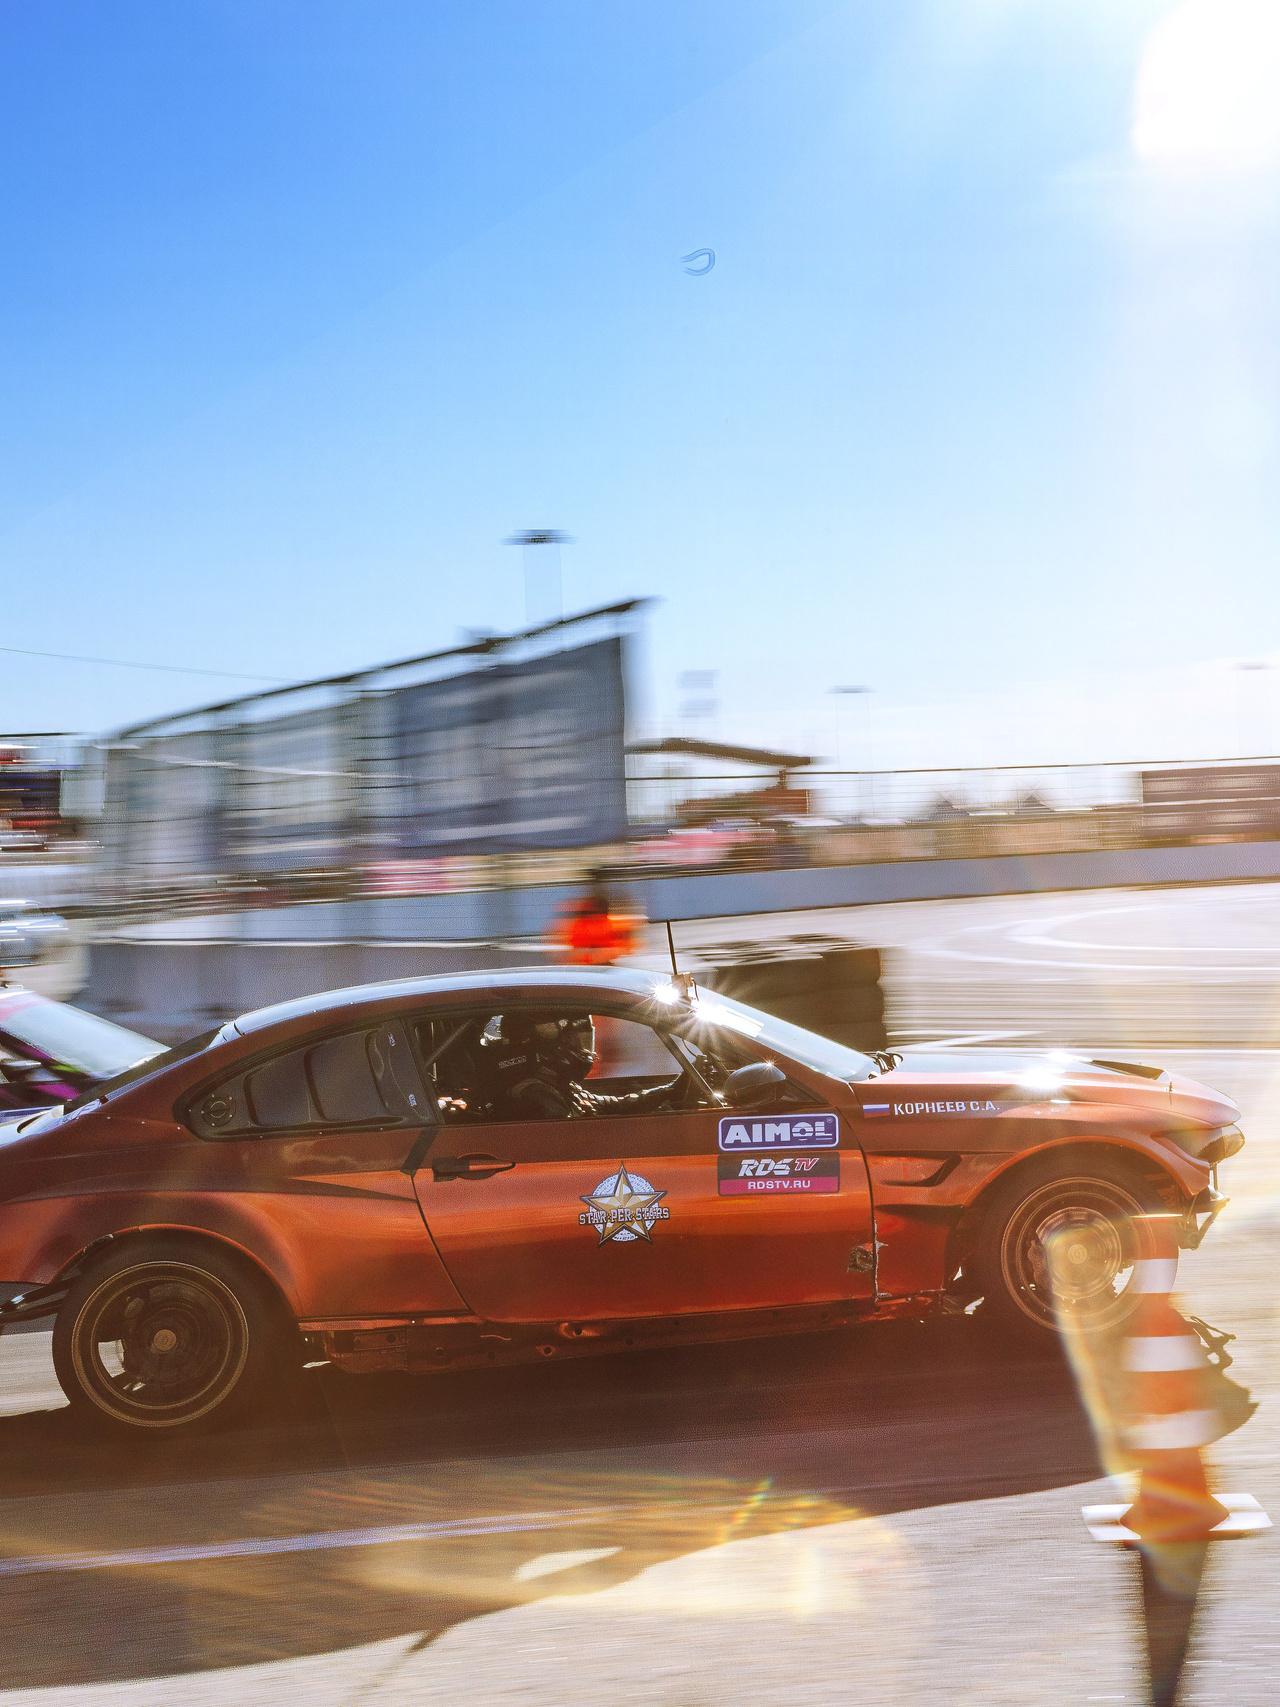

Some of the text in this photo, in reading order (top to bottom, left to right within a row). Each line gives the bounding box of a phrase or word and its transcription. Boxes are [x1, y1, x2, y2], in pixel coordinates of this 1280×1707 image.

[894, 1101, 966, 1115] КОРНЕЕВ
[724, 1121, 833, 1144] AIMOL
[747, 1180, 811, 1190] RDSTV.RU
